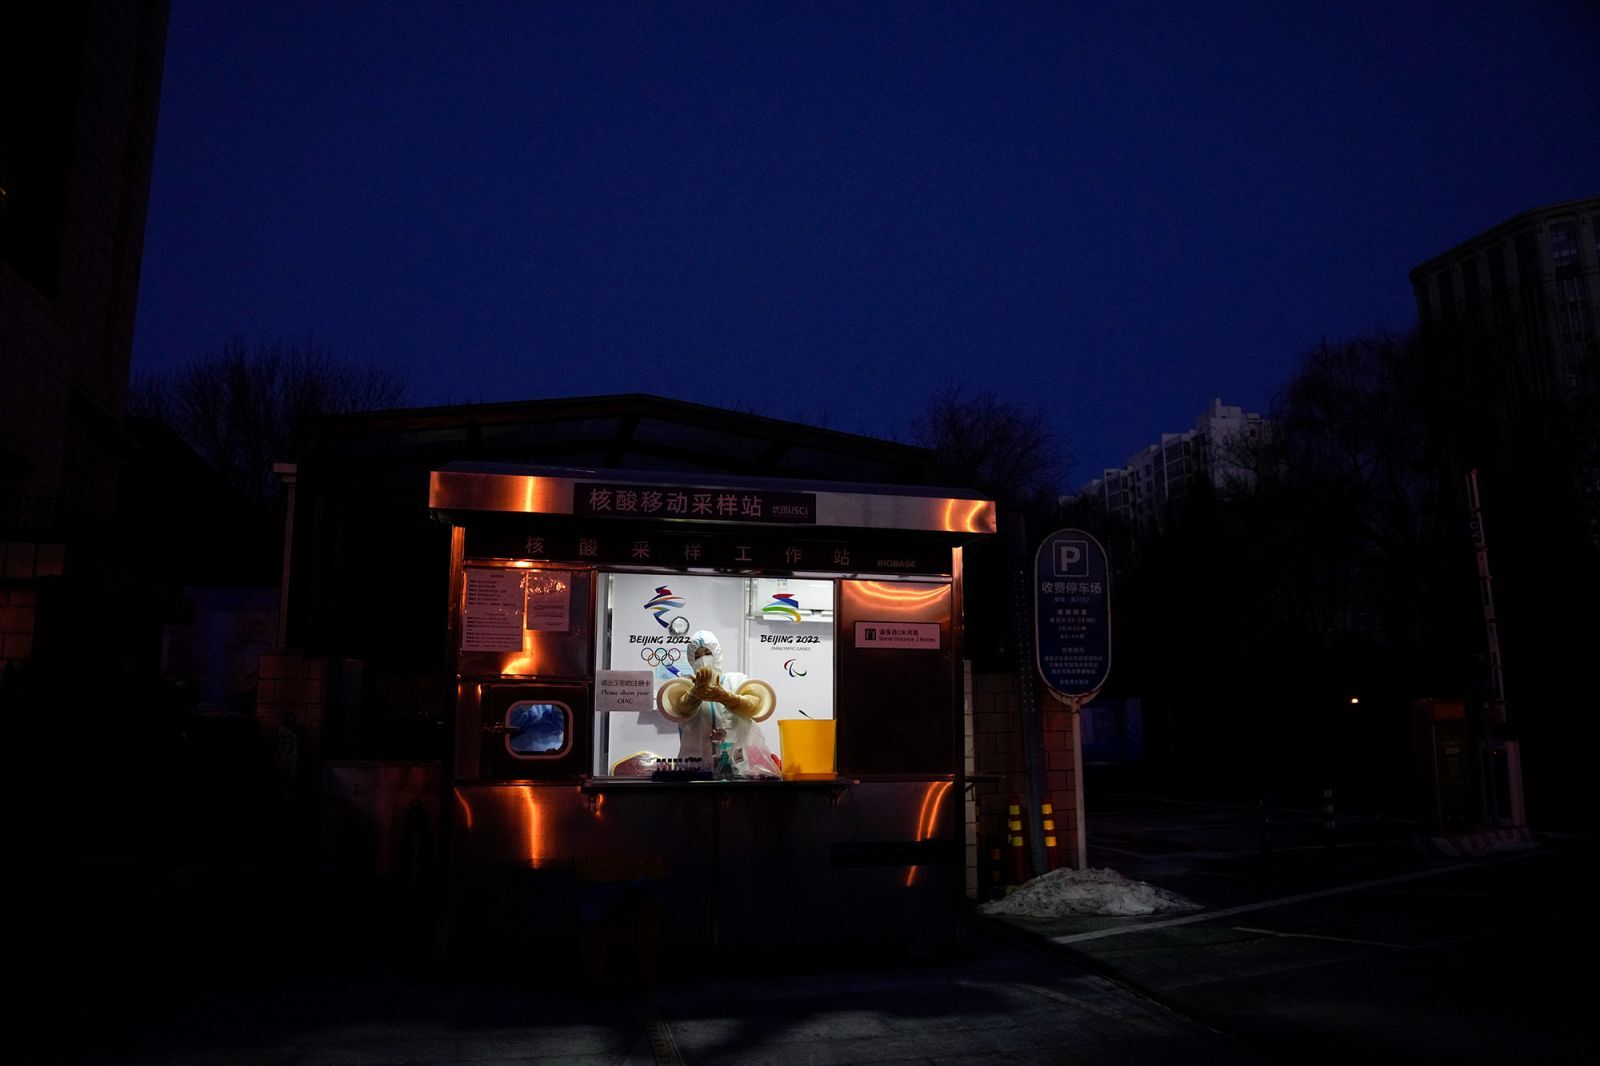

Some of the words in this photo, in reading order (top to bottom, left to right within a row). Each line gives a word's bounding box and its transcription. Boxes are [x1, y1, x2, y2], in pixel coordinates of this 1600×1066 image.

[589, 488, 763, 518] 核酸移动采样站
[525, 536, 852, 567] 核酸采样工作站
[877, 559, 917, 568] BIOBASE
[1060, 546, 1081, 572] P
[1041, 580, 1102, 594] 收费停车场
[629, 635, 664, 646] BEIJING
[666, 635, 692, 644] 2022
[760, 634, 793, 645] BEIJING
[796, 635, 821, 644] 2022
